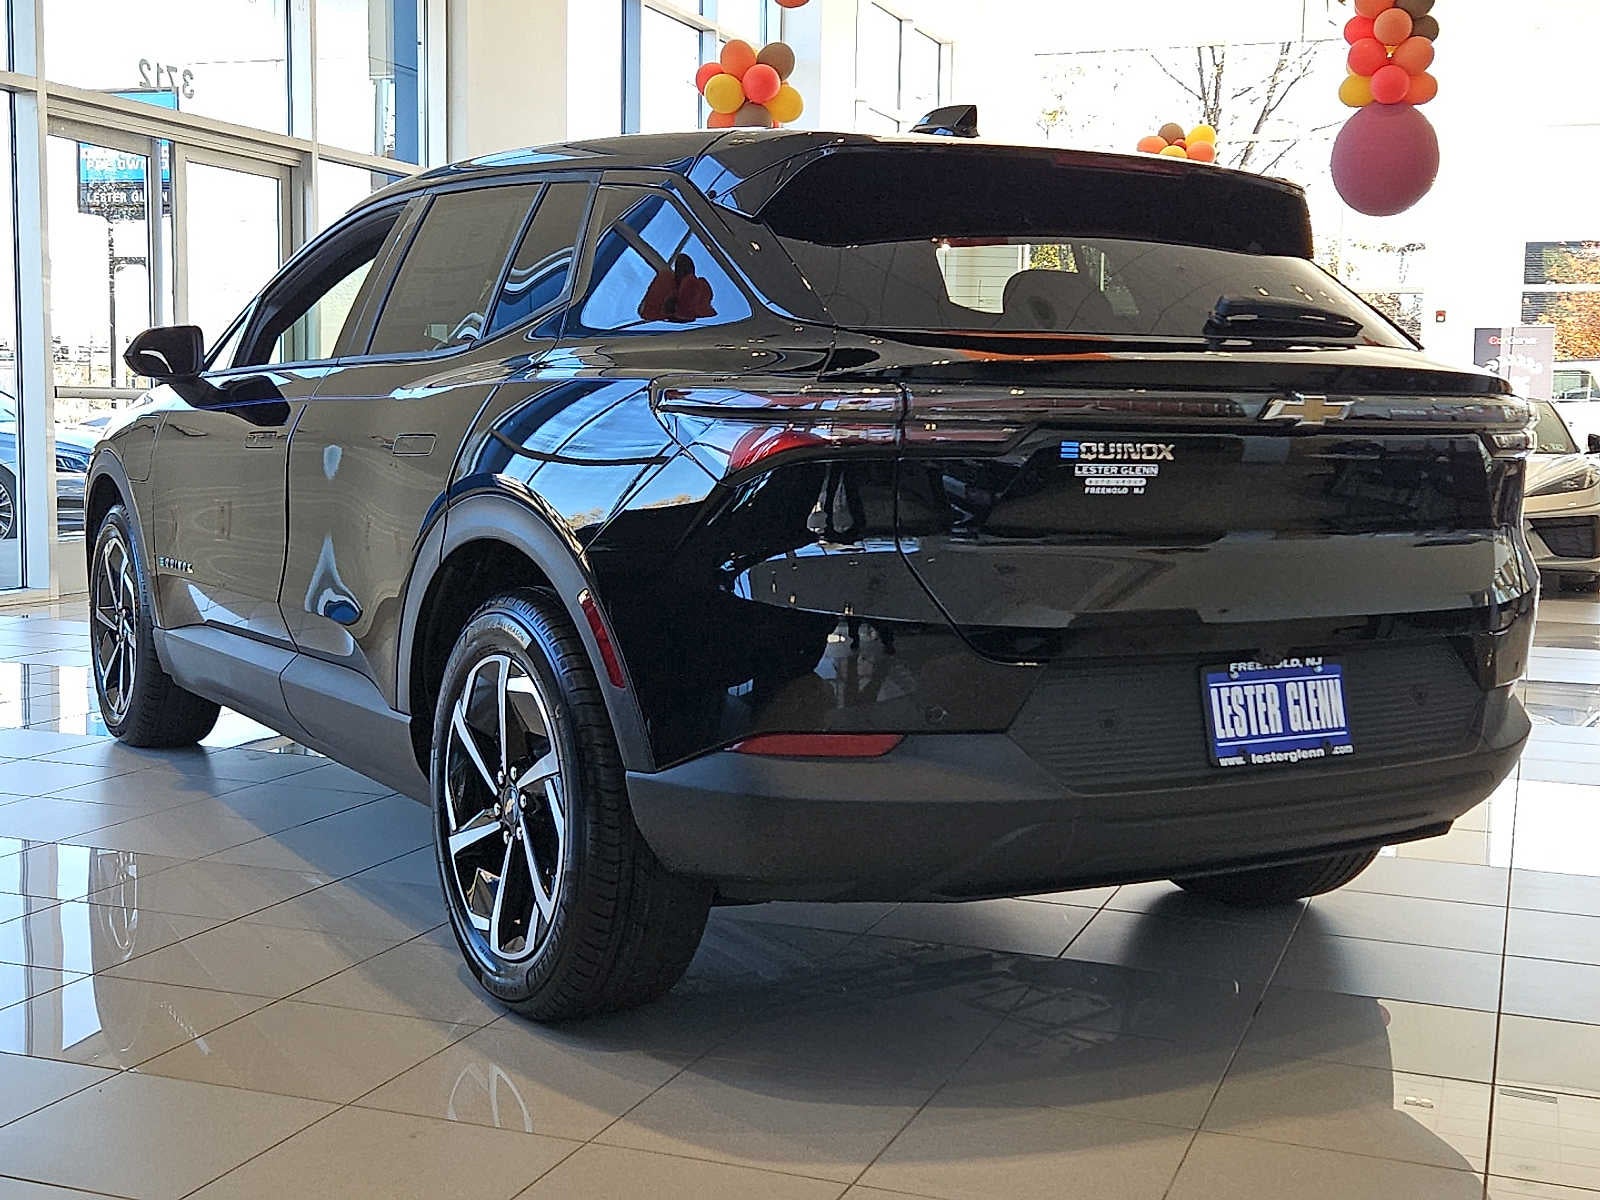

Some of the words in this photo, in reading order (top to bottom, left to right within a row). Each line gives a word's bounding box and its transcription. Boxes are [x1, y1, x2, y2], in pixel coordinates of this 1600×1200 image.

[1060, 441, 1175, 460] EQUINOX
[1074, 466, 1118, 475] LESTER
[1120, 466, 1158, 475] GLENN
[1085, 487, 1129, 495] FREEHOLD
[1133, 487, 1145, 495] NJ
[1305, 656, 1323, 667] NJ
[1210, 683, 1283, 739] LESTER
[1285, 678, 1346, 733] GLENN
